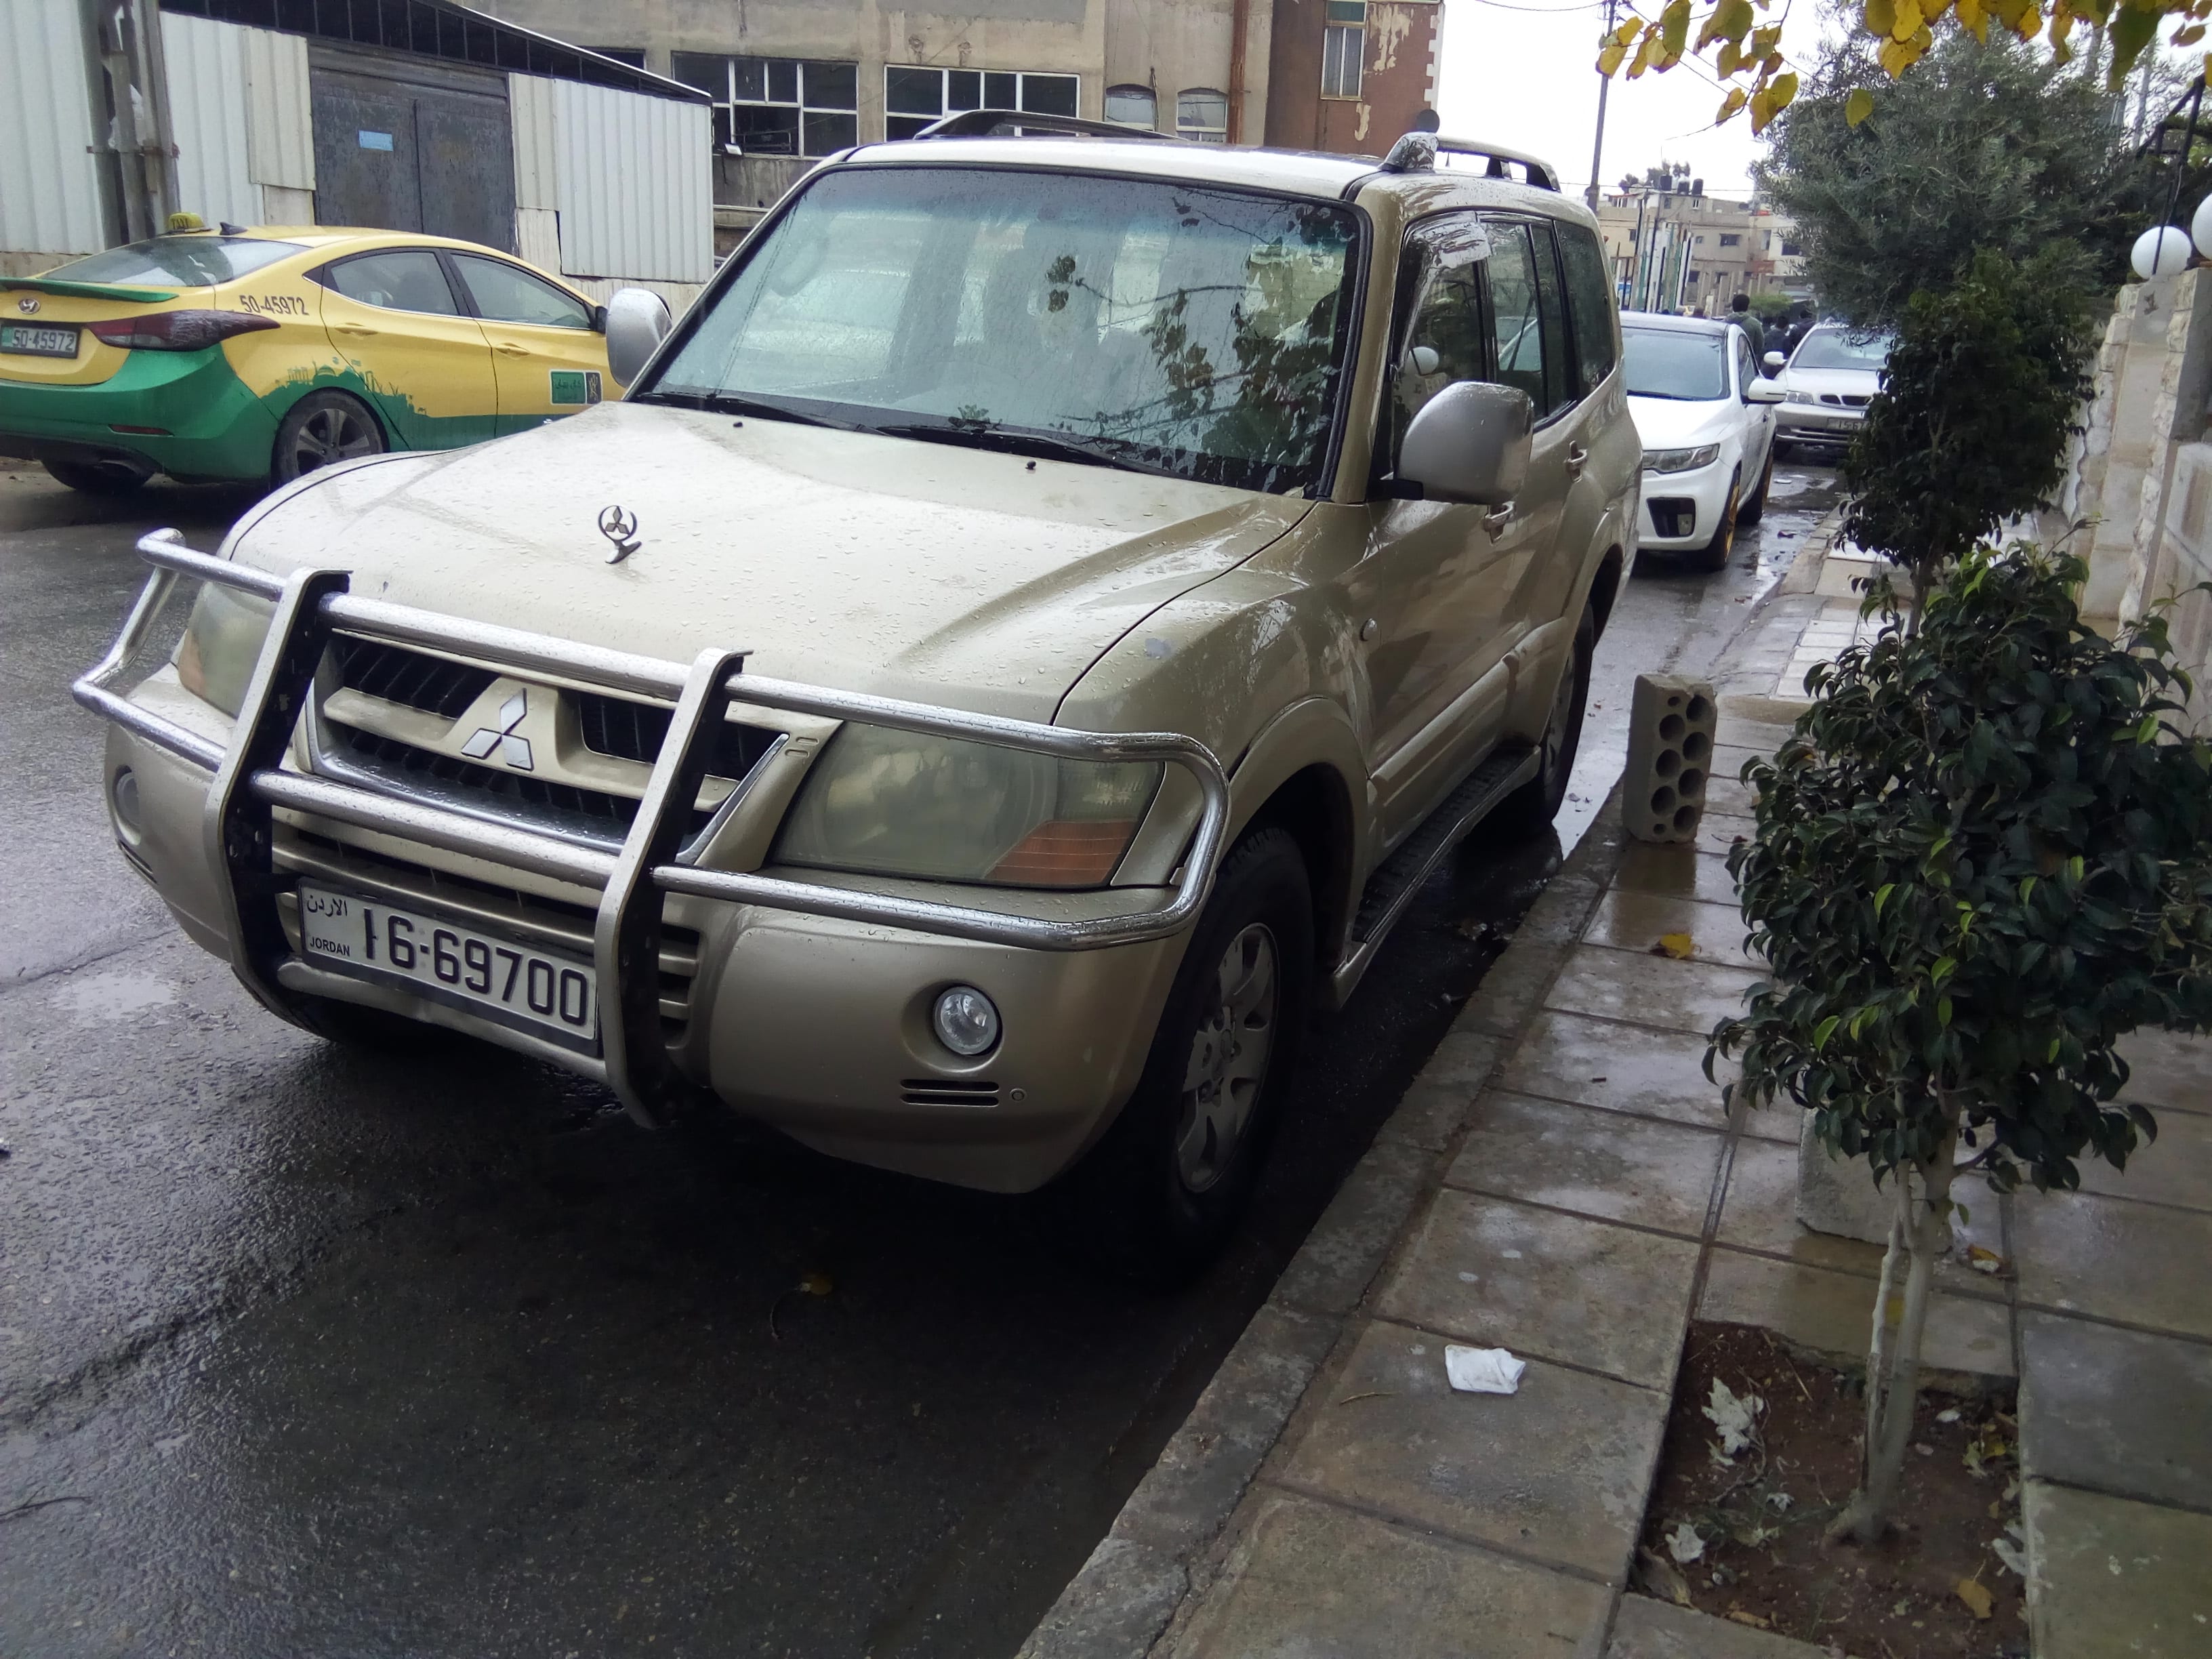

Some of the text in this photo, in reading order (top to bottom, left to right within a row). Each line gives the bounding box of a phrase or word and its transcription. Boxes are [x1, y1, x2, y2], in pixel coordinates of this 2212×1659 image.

[239, 295, 310, 315] 50-45972
[13, 329, 75, 351] 50-45972
[310, 936, 350, 957] JORDAN
[363, 907, 588, 1027] 16-69700
